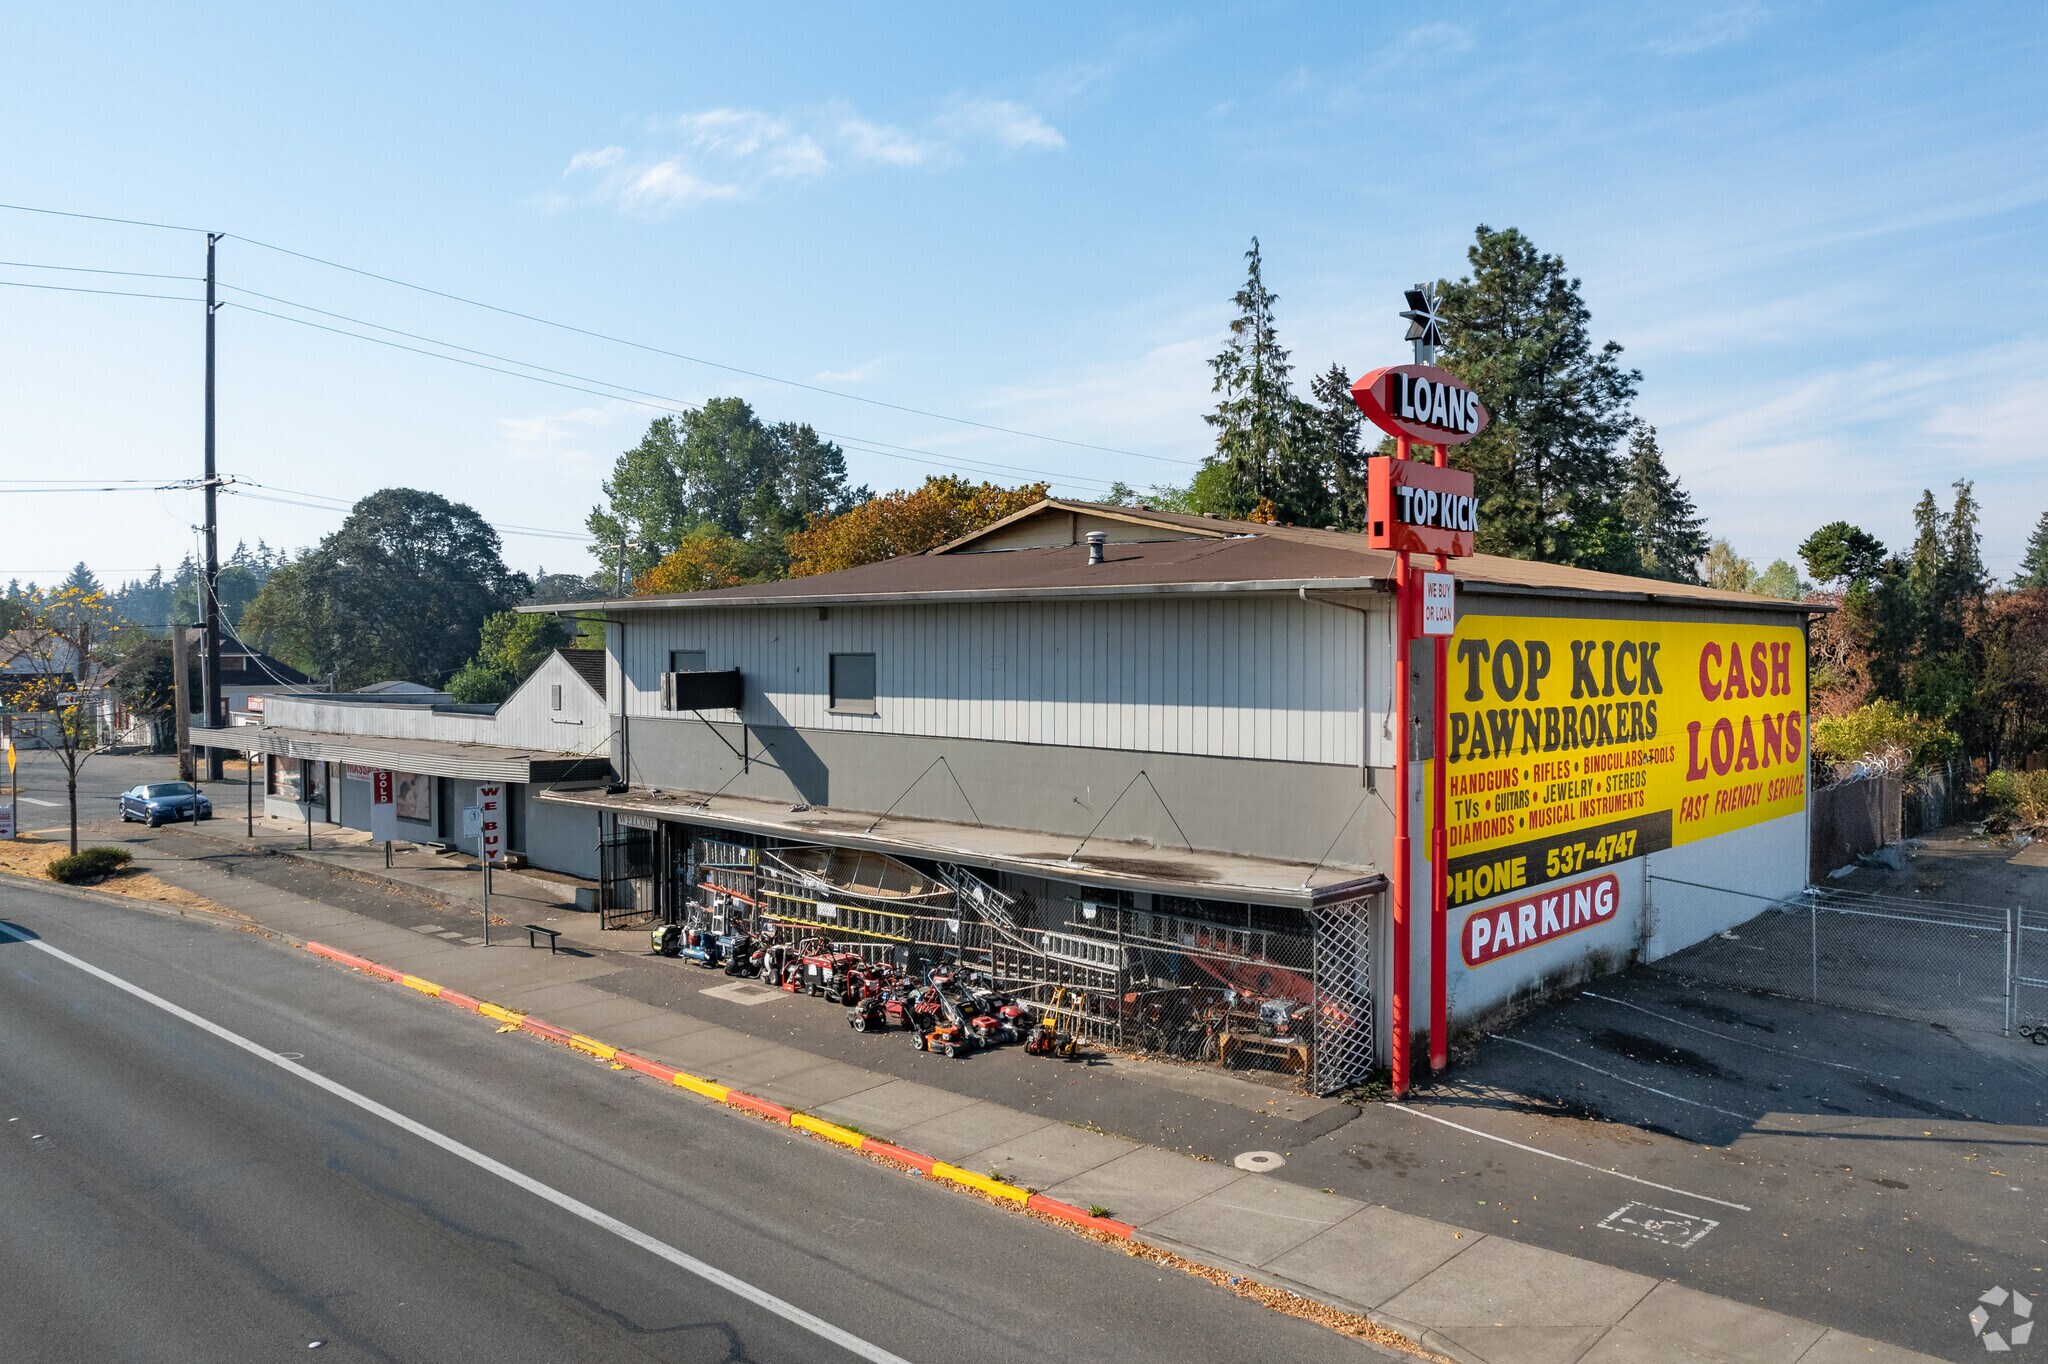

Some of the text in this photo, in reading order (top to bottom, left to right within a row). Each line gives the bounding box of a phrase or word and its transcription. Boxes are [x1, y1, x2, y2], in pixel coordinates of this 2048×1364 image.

[1401, 373, 1479, 434] LOANS
[1400, 486, 1479, 532] TOP KICK
[1426, 606, 1452, 622] OR LOAN
[1427, 583, 1451, 598] WE BUY
[1457, 638, 1663, 702] TOP KICK
[1699, 641, 1791, 701] CASH
[1449, 700, 1657, 763] PAWNBROKERS
[1686, 710, 1802, 782] LOANS
[379, 772, 388, 803] GOLD
[1450, 746, 1675, 797] HANDGUNS RIFLES BINOCULARS TOOLS
[1455, 770, 1647, 821] TVs GUITARS JEWELRY STEREOS
[480, 786, 500, 859] WE BUY
[620, 814, 656, 828] WELCOME
[1450, 790, 1645, 847] DIAMONDS MUSICAL INSTRUMENTS
[1679, 774, 1804, 824] FAST FRIENDLY SERVICE
[1546, 829, 1637, 878] 537-4747
[1471, 880, 1613, 959] PARKING
